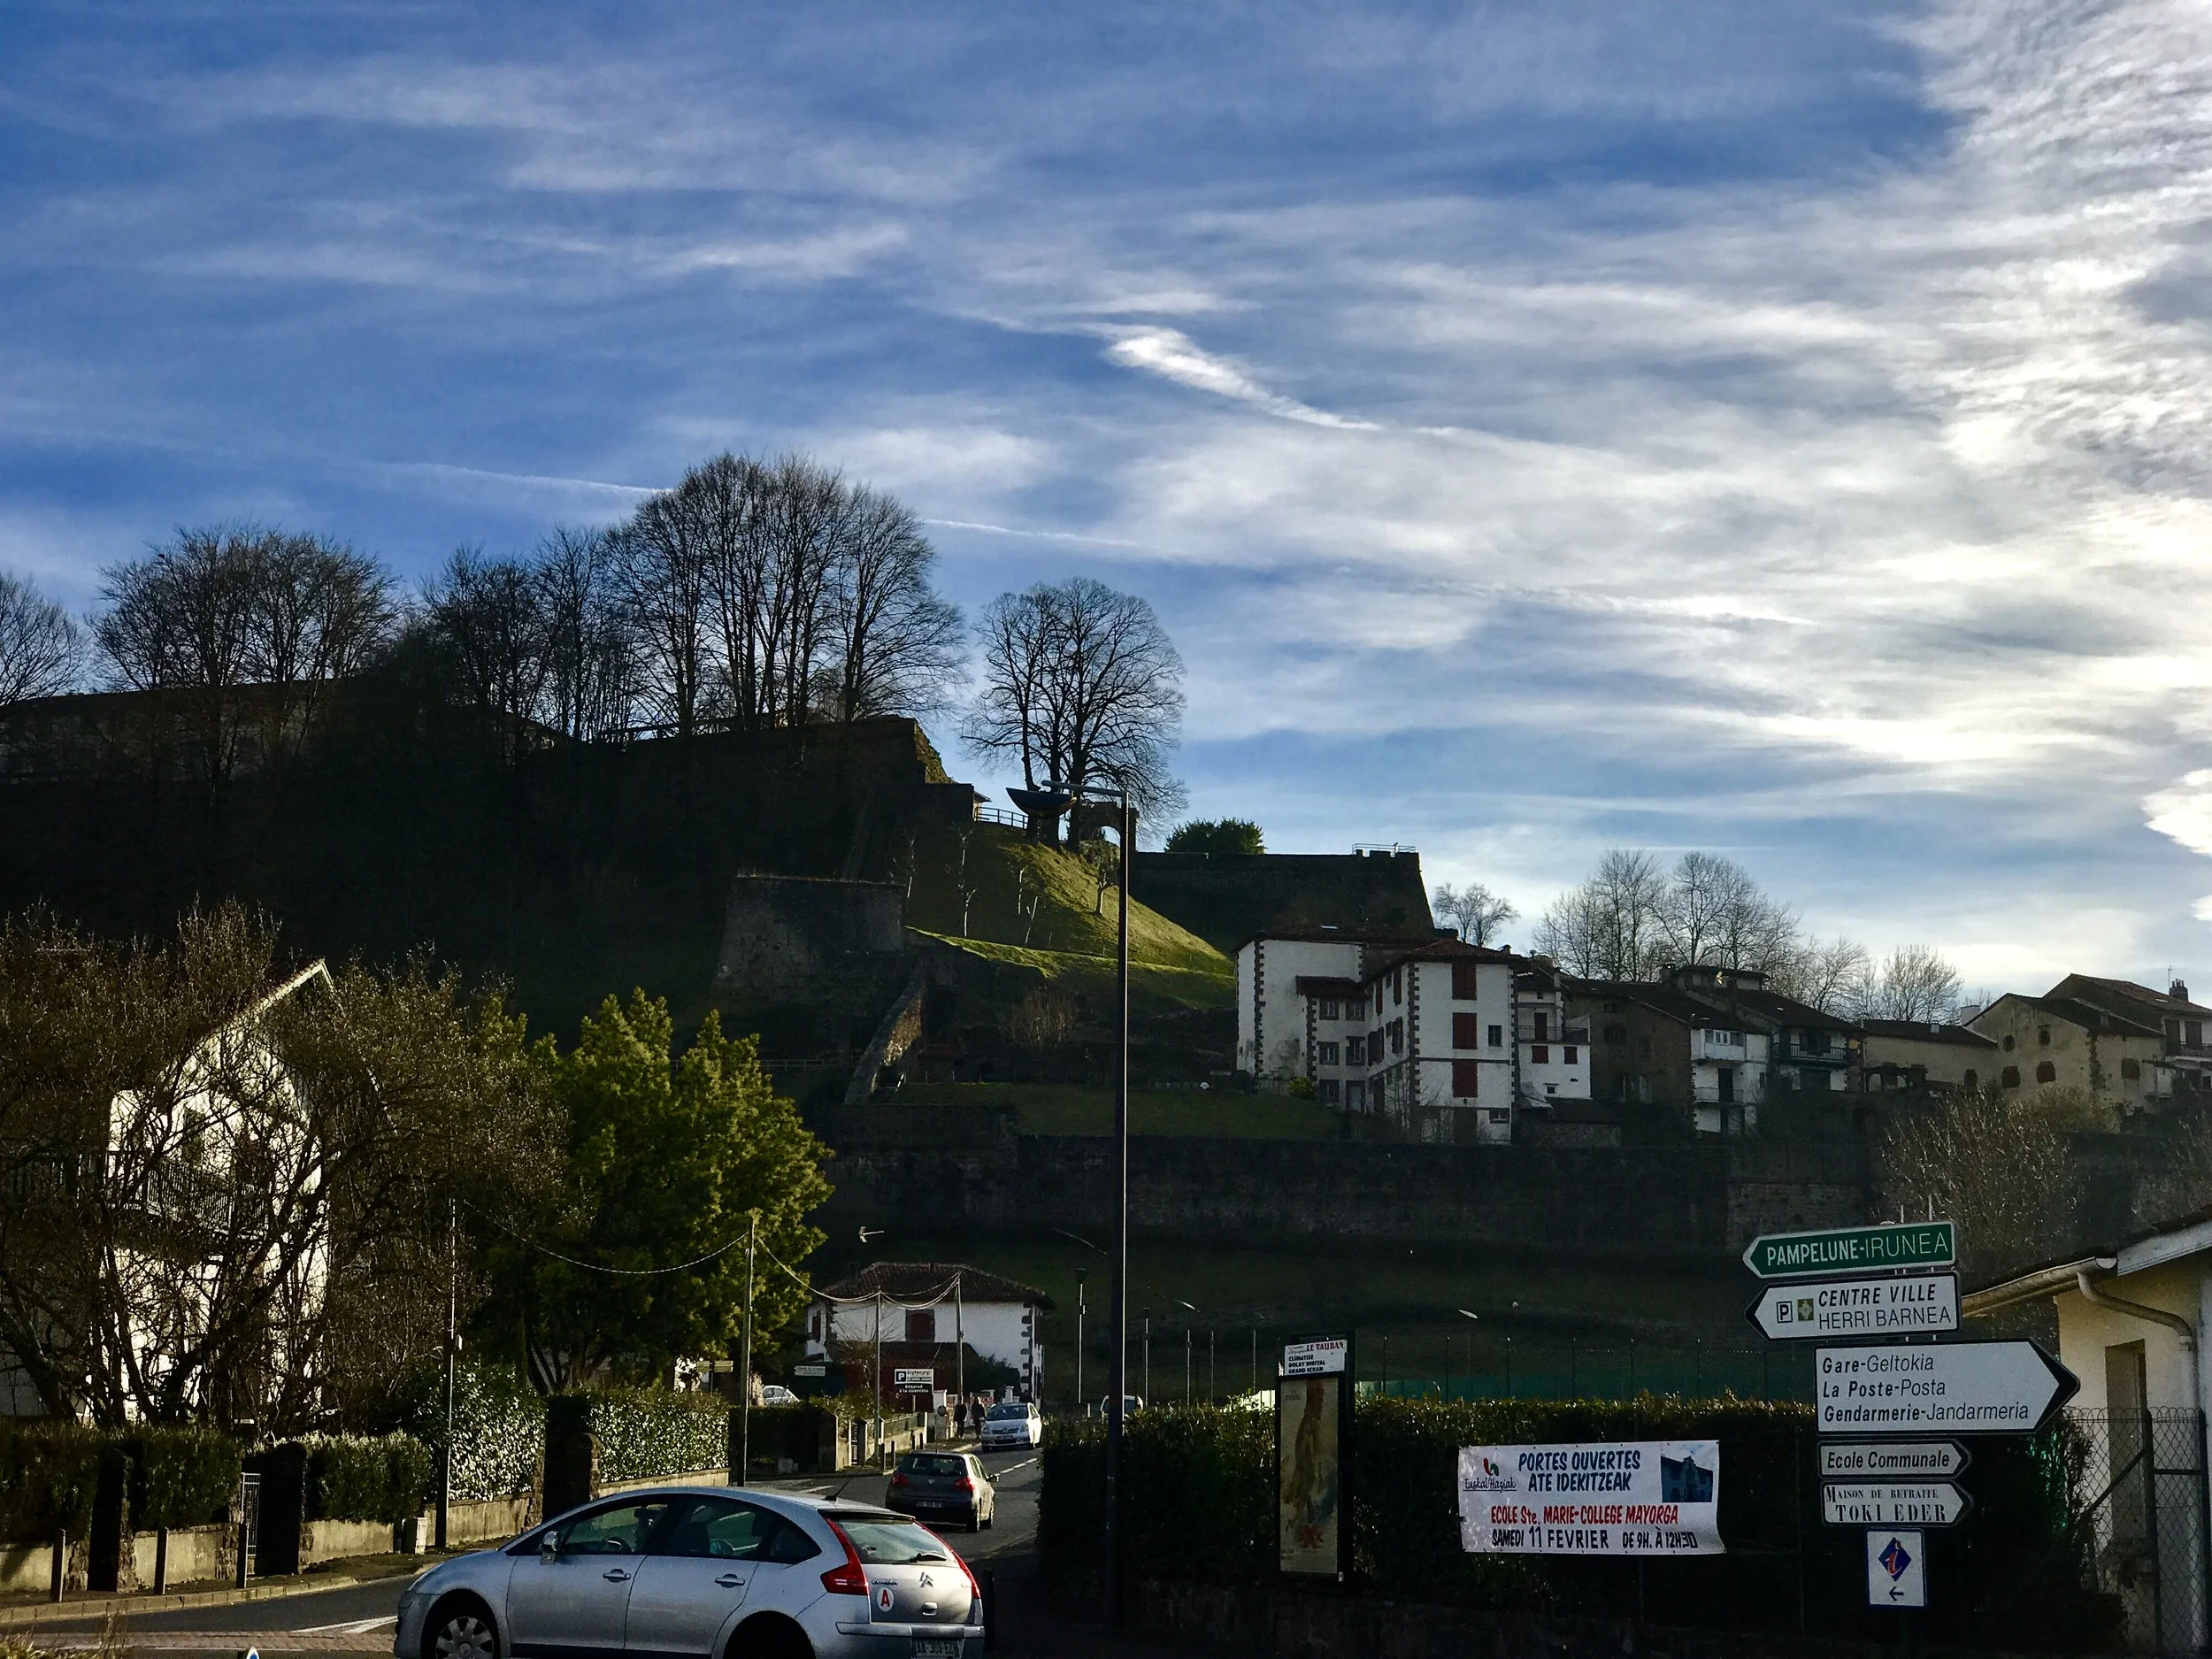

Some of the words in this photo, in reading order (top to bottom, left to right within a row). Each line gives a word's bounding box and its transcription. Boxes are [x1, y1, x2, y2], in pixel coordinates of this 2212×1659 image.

[1767, 1232, 1949, 1267] PAMPELUNE-IRUNEA
[1818, 1288, 1881, 1308] CENTRE
[1890, 1283, 1936, 1303] VILLE
[1779, 1303, 1789, 1319] P
[1818, 1311, 1870, 1330] HERRI
[1876, 1305, 1952, 1326] BARNEA
[1316, 1341, 1344, 1351] VAUBAN
[1823, 1354, 1934, 1374] Gare-Geltokia
[898, 1372, 905, 1381] P
[1824, 1381, 1839, 1399] La
[1848, 1379, 1947, 1398] Poste-Posta
[1824, 1401, 2029, 1423] Gendarmerie-Jandarmeria
[1518, 1452, 1567, 1471] PORTES
[1571, 1450, 1641, 1471] OUVERTES
[1827, 1451, 1863, 1469] Ecole
[1868, 1450, 1949, 1468] Communale
[1528, 1472, 1552, 1493] ATE
[1556, 1471, 1632, 1492] IDEKITZEAK
[1870, 1489, 1883, 1499] DE
[1890, 1488, 1939, 1499] RETRAITE
[1491, 1506, 1518, 1525] ECOLE
[1543, 1504, 1622, 1525] MARIE-COLLEGE
[1625, 1504, 1678, 1525] MAYORGA
[1835, 1504, 1881, 1522] TOKI
[1894, 1504, 1946, 1522] EDER
[1492, 1528, 1524, 1547] SAMEDI
[1528, 1526, 1542, 1548] 11
[1548, 1529, 1609, 1549] FEVRIER
[1622, 1532, 1634, 1548] DE
[880, 1589, 890, 1607] A
